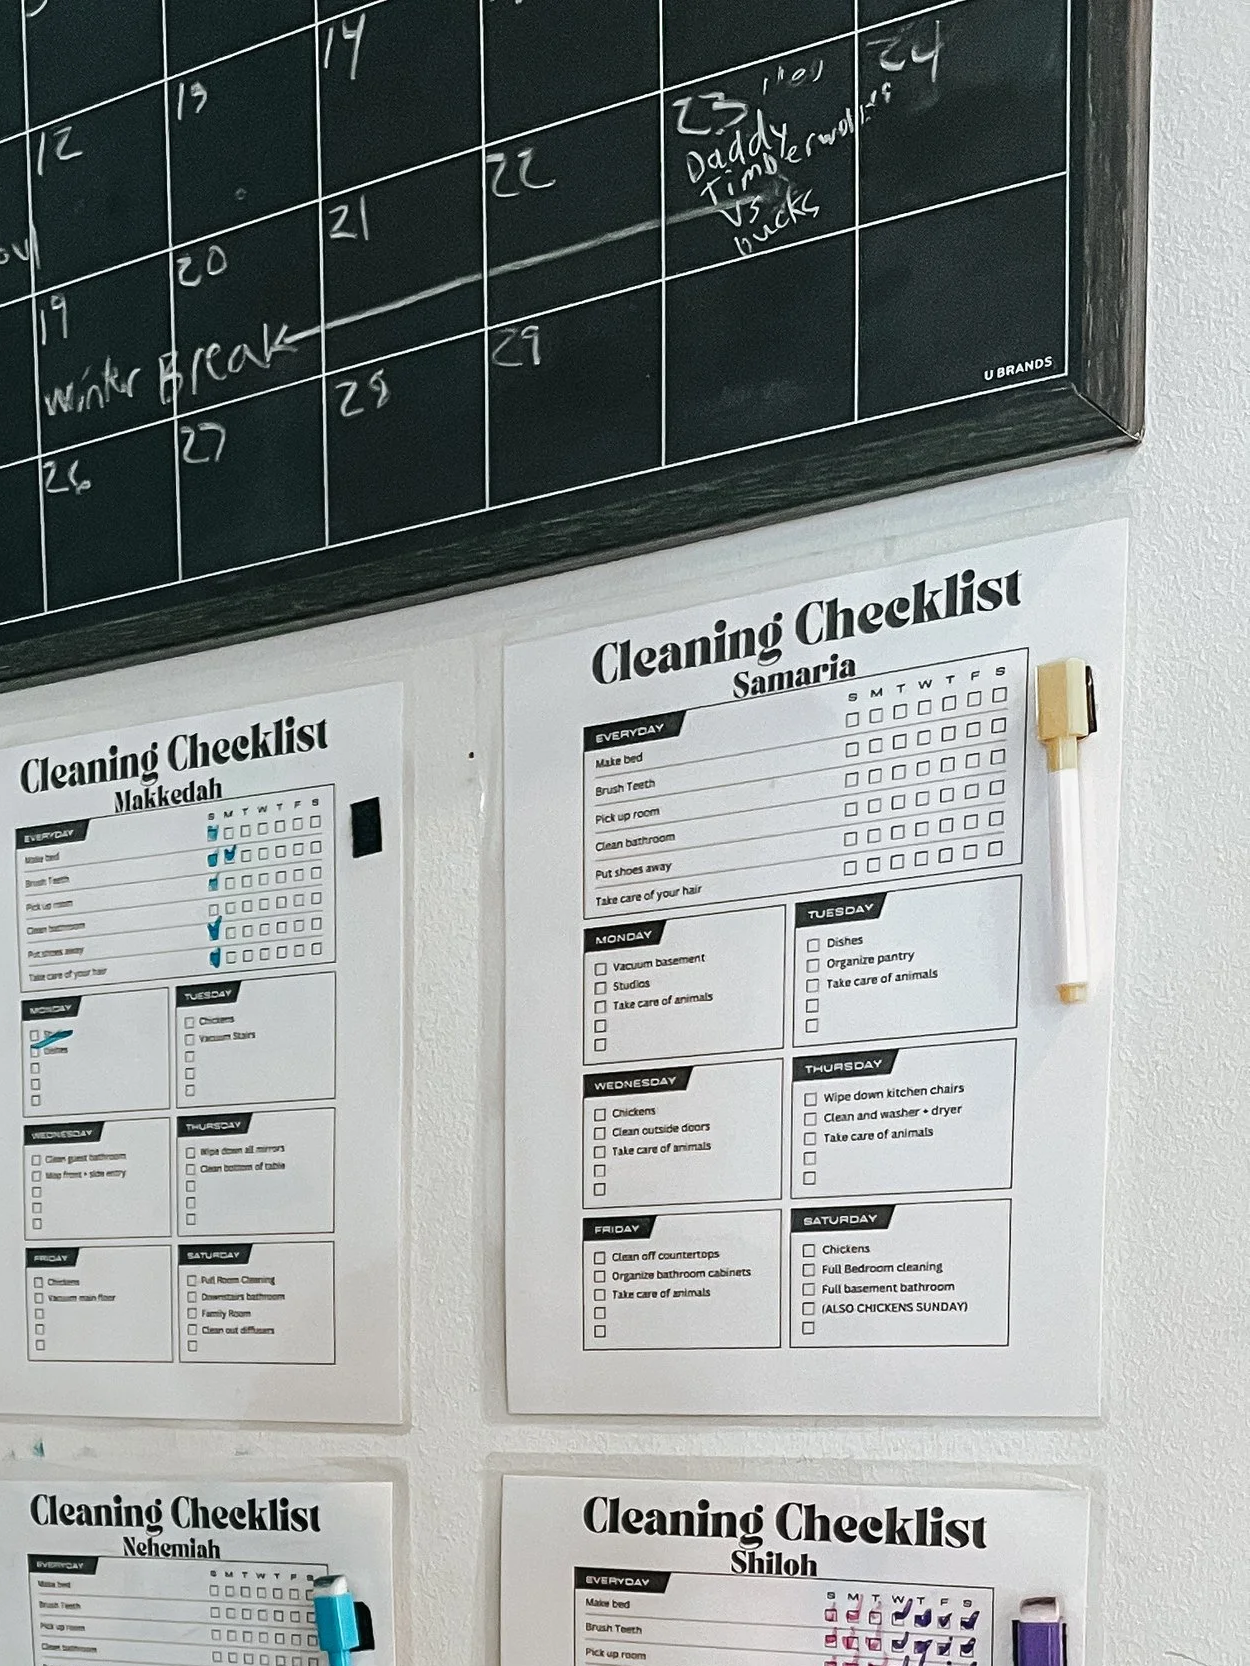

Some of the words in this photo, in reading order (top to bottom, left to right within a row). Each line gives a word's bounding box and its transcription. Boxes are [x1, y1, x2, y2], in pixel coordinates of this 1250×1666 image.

[323, 12, 367, 80] 14
[866, 19, 945, 83] 24
[672, 91, 749, 136] 23
[37, 125, 84, 176] 12
[686, 108, 788, 184] Daddy
[485, 149, 557, 198] 22
[329, 196, 371, 241] 21
[177, 244, 228, 288] 20
[40, 291, 69, 347] 19
[491, 325, 543, 368] 29
[983, 369, 995, 382] U
[996, 355, 1054, 379] BRANDS
[337, 368, 392, 420] 28
[180, 421, 227, 465] 27
[42, 459, 93, 497] 26
[591, 611, 783, 685] Cleaning
[794, 568, 1021, 645] Checklist
[732, 652, 856, 699] Samaria
[847, 692, 858, 702] S
[870, 686, 883, 698] M
[895, 682, 906, 693] T
[917, 678, 932, 689] W
[944, 674, 955, 684] T
[970, 669, 980, 681] F
[994, 665, 1005, 676] S
[595, 722, 664, 743] EVERYDAY
[20, 741, 159, 794] Cleaning
[167, 715, 328, 771] Checklist
[594, 756, 621, 768] Make
[623, 751, 643, 764] bed
[114, 776, 222, 813] Makkedah
[595, 783, 624, 797] Brush
[626, 778, 655, 791] Teeth
[594, 812, 616, 824] Pick
[617, 811, 631, 822] up
[632, 807, 660, 819] room
[594, 840, 623, 852] Clean
[624, 833, 675, 848] bathroom
[594, 869, 613, 879] Put
[613, 865, 643, 877] shoes
[645, 862, 672, 873] away
[595, 895, 618, 906] Take
[619, 893, 642, 904] care
[642, 888, 655, 901] of
[655, 887, 680, 902] your
[681, 885, 702, 895] hair
[807, 902, 874, 918] TUESDAY
[595, 930, 652, 944] MONDAY
[826, 935, 863, 948] Dishes
[612, 959, 653, 972] Vacuum
[654, 953, 705, 967] basement
[826, 955, 874, 970] Organize
[876, 951, 915, 965] pantry
[826, 977, 851, 989] Take
[853, 976, 878, 987] care
[879, 971, 893, 984] of
[612, 1000, 635, 1010] Take
[636, 998, 659, 1008] care
[660, 994, 672, 1006] of
[804, 1059, 882, 1073] THURSDAY
[593, 1075, 676, 1090] WEDNESDAY
[823, 1091, 851, 1104] Wipe
[853, 1089, 884, 1101] down
[886, 1086, 927, 1098] kitchen
[929, 1083, 964, 1095] chairs
[611, 1106, 656, 1118] Chickens
[823, 1112, 854, 1123] Clean
[856, 1109, 878, 1120] and
[879, 1107, 920, 1119] washer
[930, 1104, 962, 1117] dryer
[611, 1126, 640, 1137] Clean
[641, 1123, 679, 1135] outside
[680, 1122, 710, 1132] doors
[823, 1132, 848, 1143] Take
[850, 1132, 874, 1141] care
[876, 1128, 889, 1140] of
[611, 1145, 634, 1156] Take
[635, 1145, 658, 1155] care
[659, 1142, 671, 1153] of
[594, 1224, 639, 1233] FRIDAY
[803, 1214, 877, 1225] SATURDAY
[611, 1251, 639, 1262] Clean
[640, 1250, 656, 1261] off
[657, 1250, 720, 1260] countertops
[821, 1244, 870, 1255] Chickens
[611, 1270, 655, 1283] Organize
[656, 1269, 706, 1279] bathroom
[707, 1267, 751, 1278] cabinets
[821, 1263, 842, 1274] Full
[843, 1263, 894, 1274] Bedroom
[895, 1261, 943, 1273] cleaning
[611, 1289, 634, 1299] Take
[635, 1290, 658, 1299] care
[659, 1287, 671, 1298] of
[821, 1283, 841, 1294] Full
[843, 1283, 898, 1294] basement
[899, 1281, 955, 1292] bathroom
[821, 1303, 854, 1314] (ALSO
[856, 1302, 913, 1313] CHICKENS
[915, 1301, 968, 1312] SUNDAY)
[29, 1493, 163, 1537] Cleaning
[170, 1495, 321, 1532] Checklist
[582, 1495, 763, 1550] Cleaning
[775, 1501, 987, 1549] Checklist
[122, 1535, 221, 1559] Nehemiah
[730, 1549, 817, 1577] Shiloh
[585, 1575, 649, 1586] EVERYDAY
